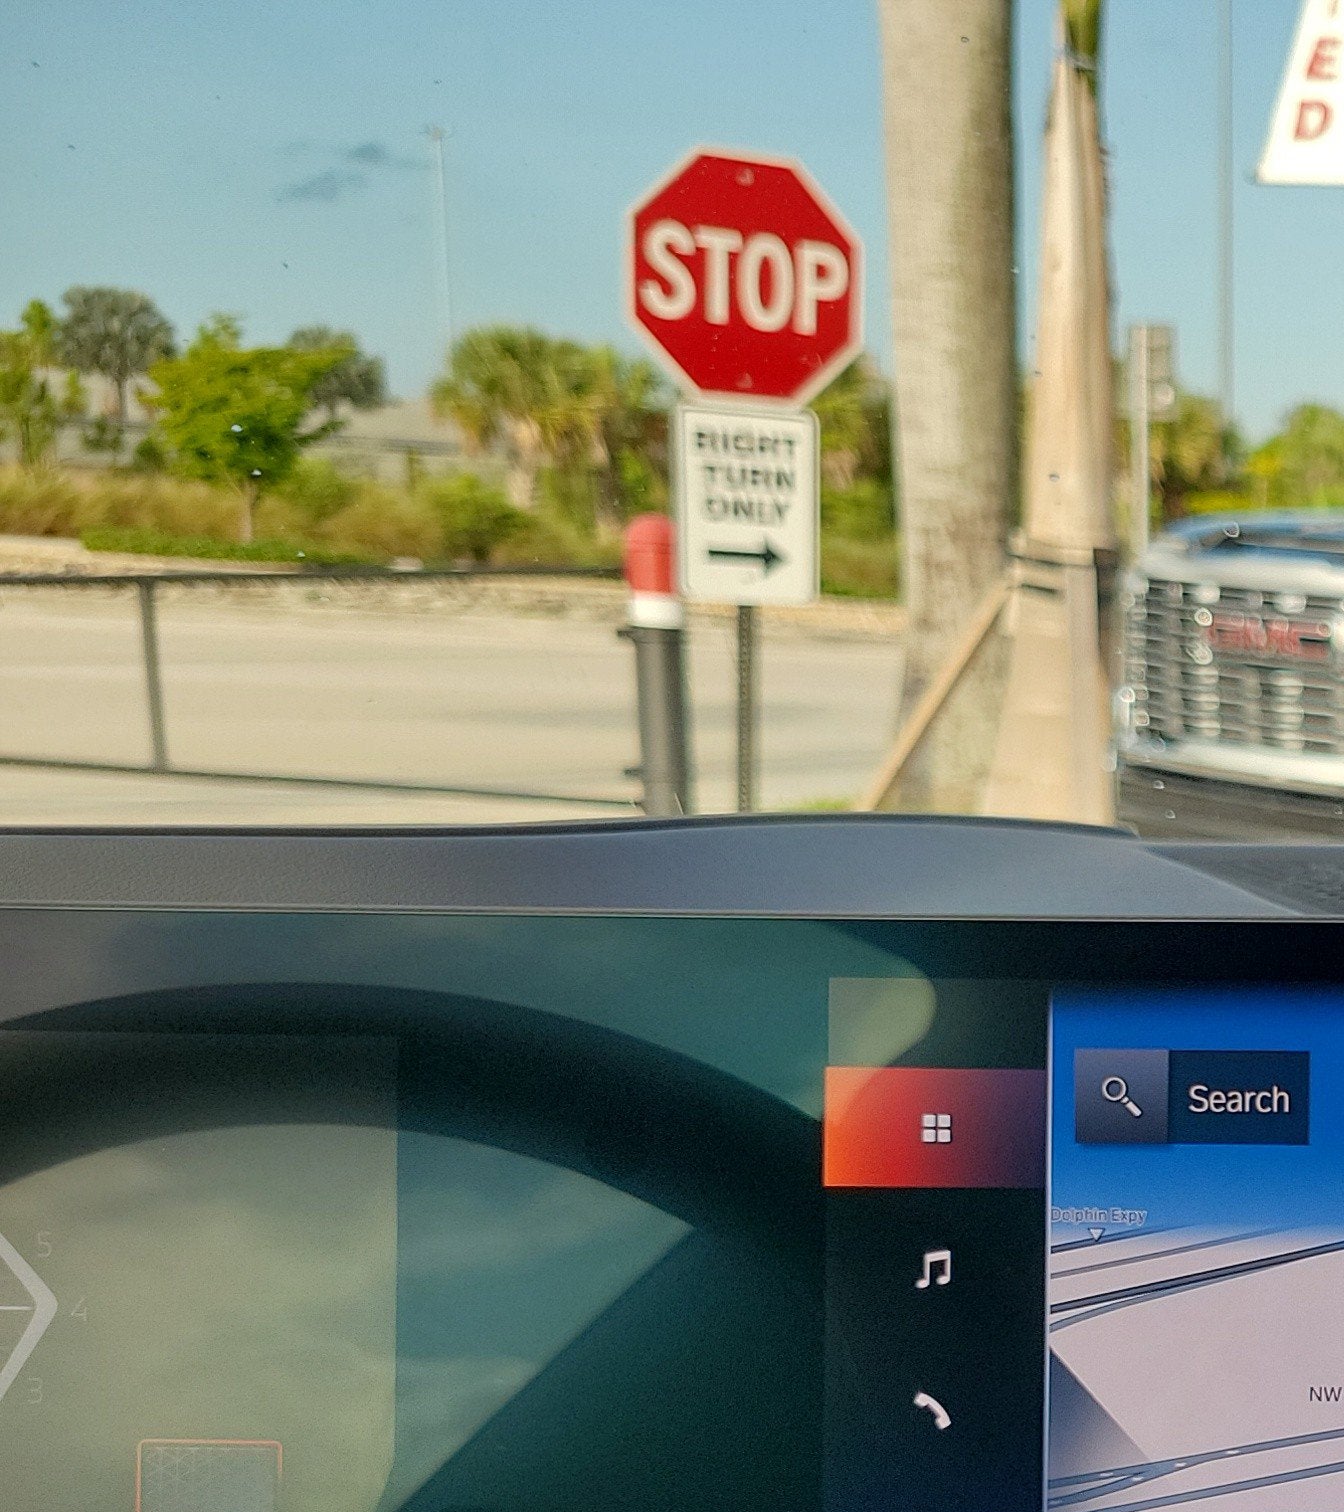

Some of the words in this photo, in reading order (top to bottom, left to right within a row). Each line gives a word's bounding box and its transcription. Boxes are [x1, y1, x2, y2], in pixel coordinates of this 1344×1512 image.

[641, 218, 850, 337] STOP
[695, 428, 800, 459] RIGHT
[702, 463, 797, 491] TURN
[703, 499, 792, 526] ONLY
[1188, 1084, 1291, 1114] Search
[1051, 1206, 1107, 1224] Dolphin
[1111, 1207, 1147, 1226] Expy
[1308, 1386, 1343, 1403] NW
